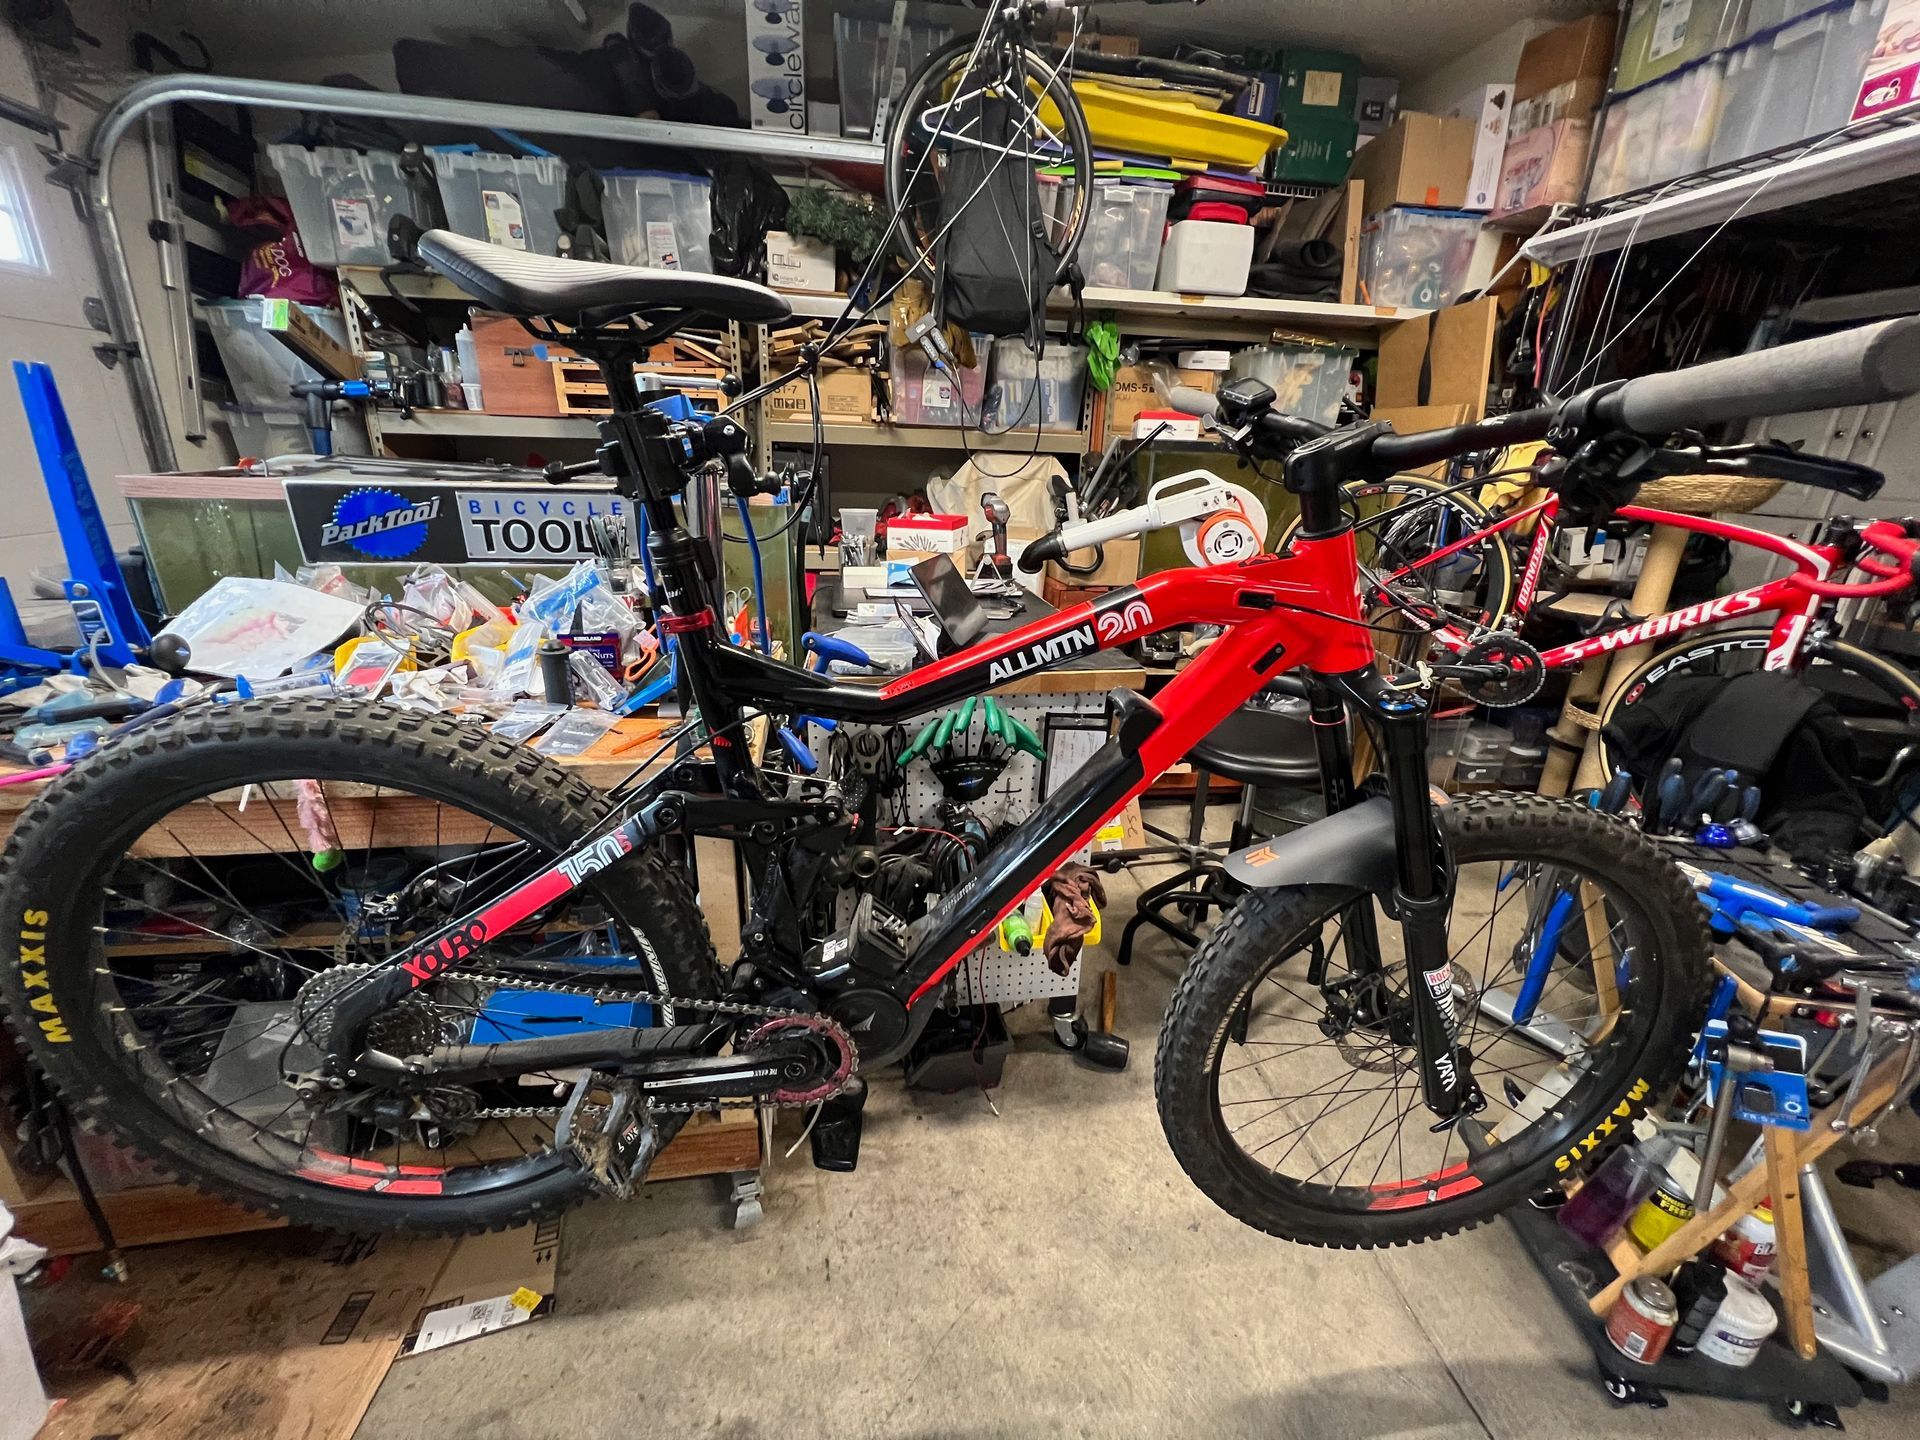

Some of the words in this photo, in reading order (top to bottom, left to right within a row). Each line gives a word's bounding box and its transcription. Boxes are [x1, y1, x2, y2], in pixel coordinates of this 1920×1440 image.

[271, 248, 292, 277] DOG
[321, 496, 440, 547] ParkTool
[469, 500, 622, 516] BICYCLE
[1387, 485, 1493, 549] EASTO
[471, 518, 600, 555] TOOL
[1517, 534, 1546, 607] SPECIALIZED
[989, 624, 1095, 685] ALLMTN
[1561, 590, 1763, 663] S-WORKS
[1646, 639, 1771, 683] EASTO
[19, 908, 73, 1043] MAXXIS
[402, 920, 488, 987] XDURO
[1433, 980, 1452, 996] SHO
[1554, 1077, 1650, 1173] MAXXIS
[1754, 1243, 1774, 1256] BL
